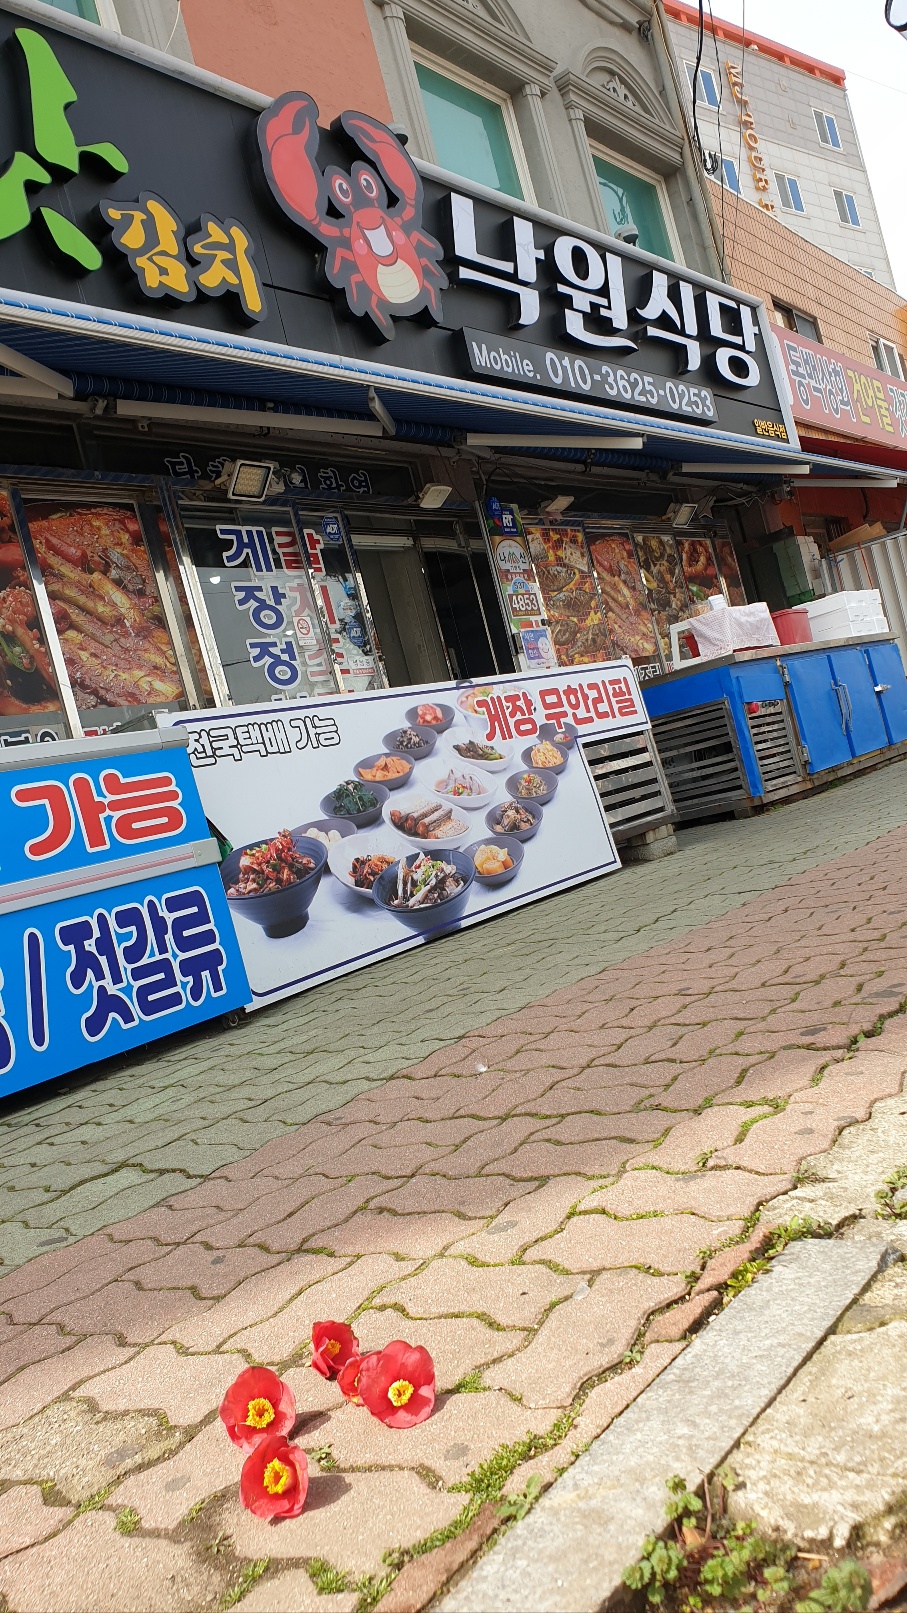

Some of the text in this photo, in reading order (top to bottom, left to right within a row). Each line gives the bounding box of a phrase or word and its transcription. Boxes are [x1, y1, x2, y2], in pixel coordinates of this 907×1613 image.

[739, 112, 769, 193] TOUR
[107, 199, 263, 314] 김치
[450, 191, 761, 388] 낙원식당
[471, 341, 714, 418] Mobile. 010-3625-0253
[511, 594, 539, 611] 4853
[187, 714, 341, 768] 전국택배 가능
[475, 676, 638, 743] 게장 무한리필
[11, 768, 188, 862] 가능
[54, 885, 227, 1043] 젓갈류
